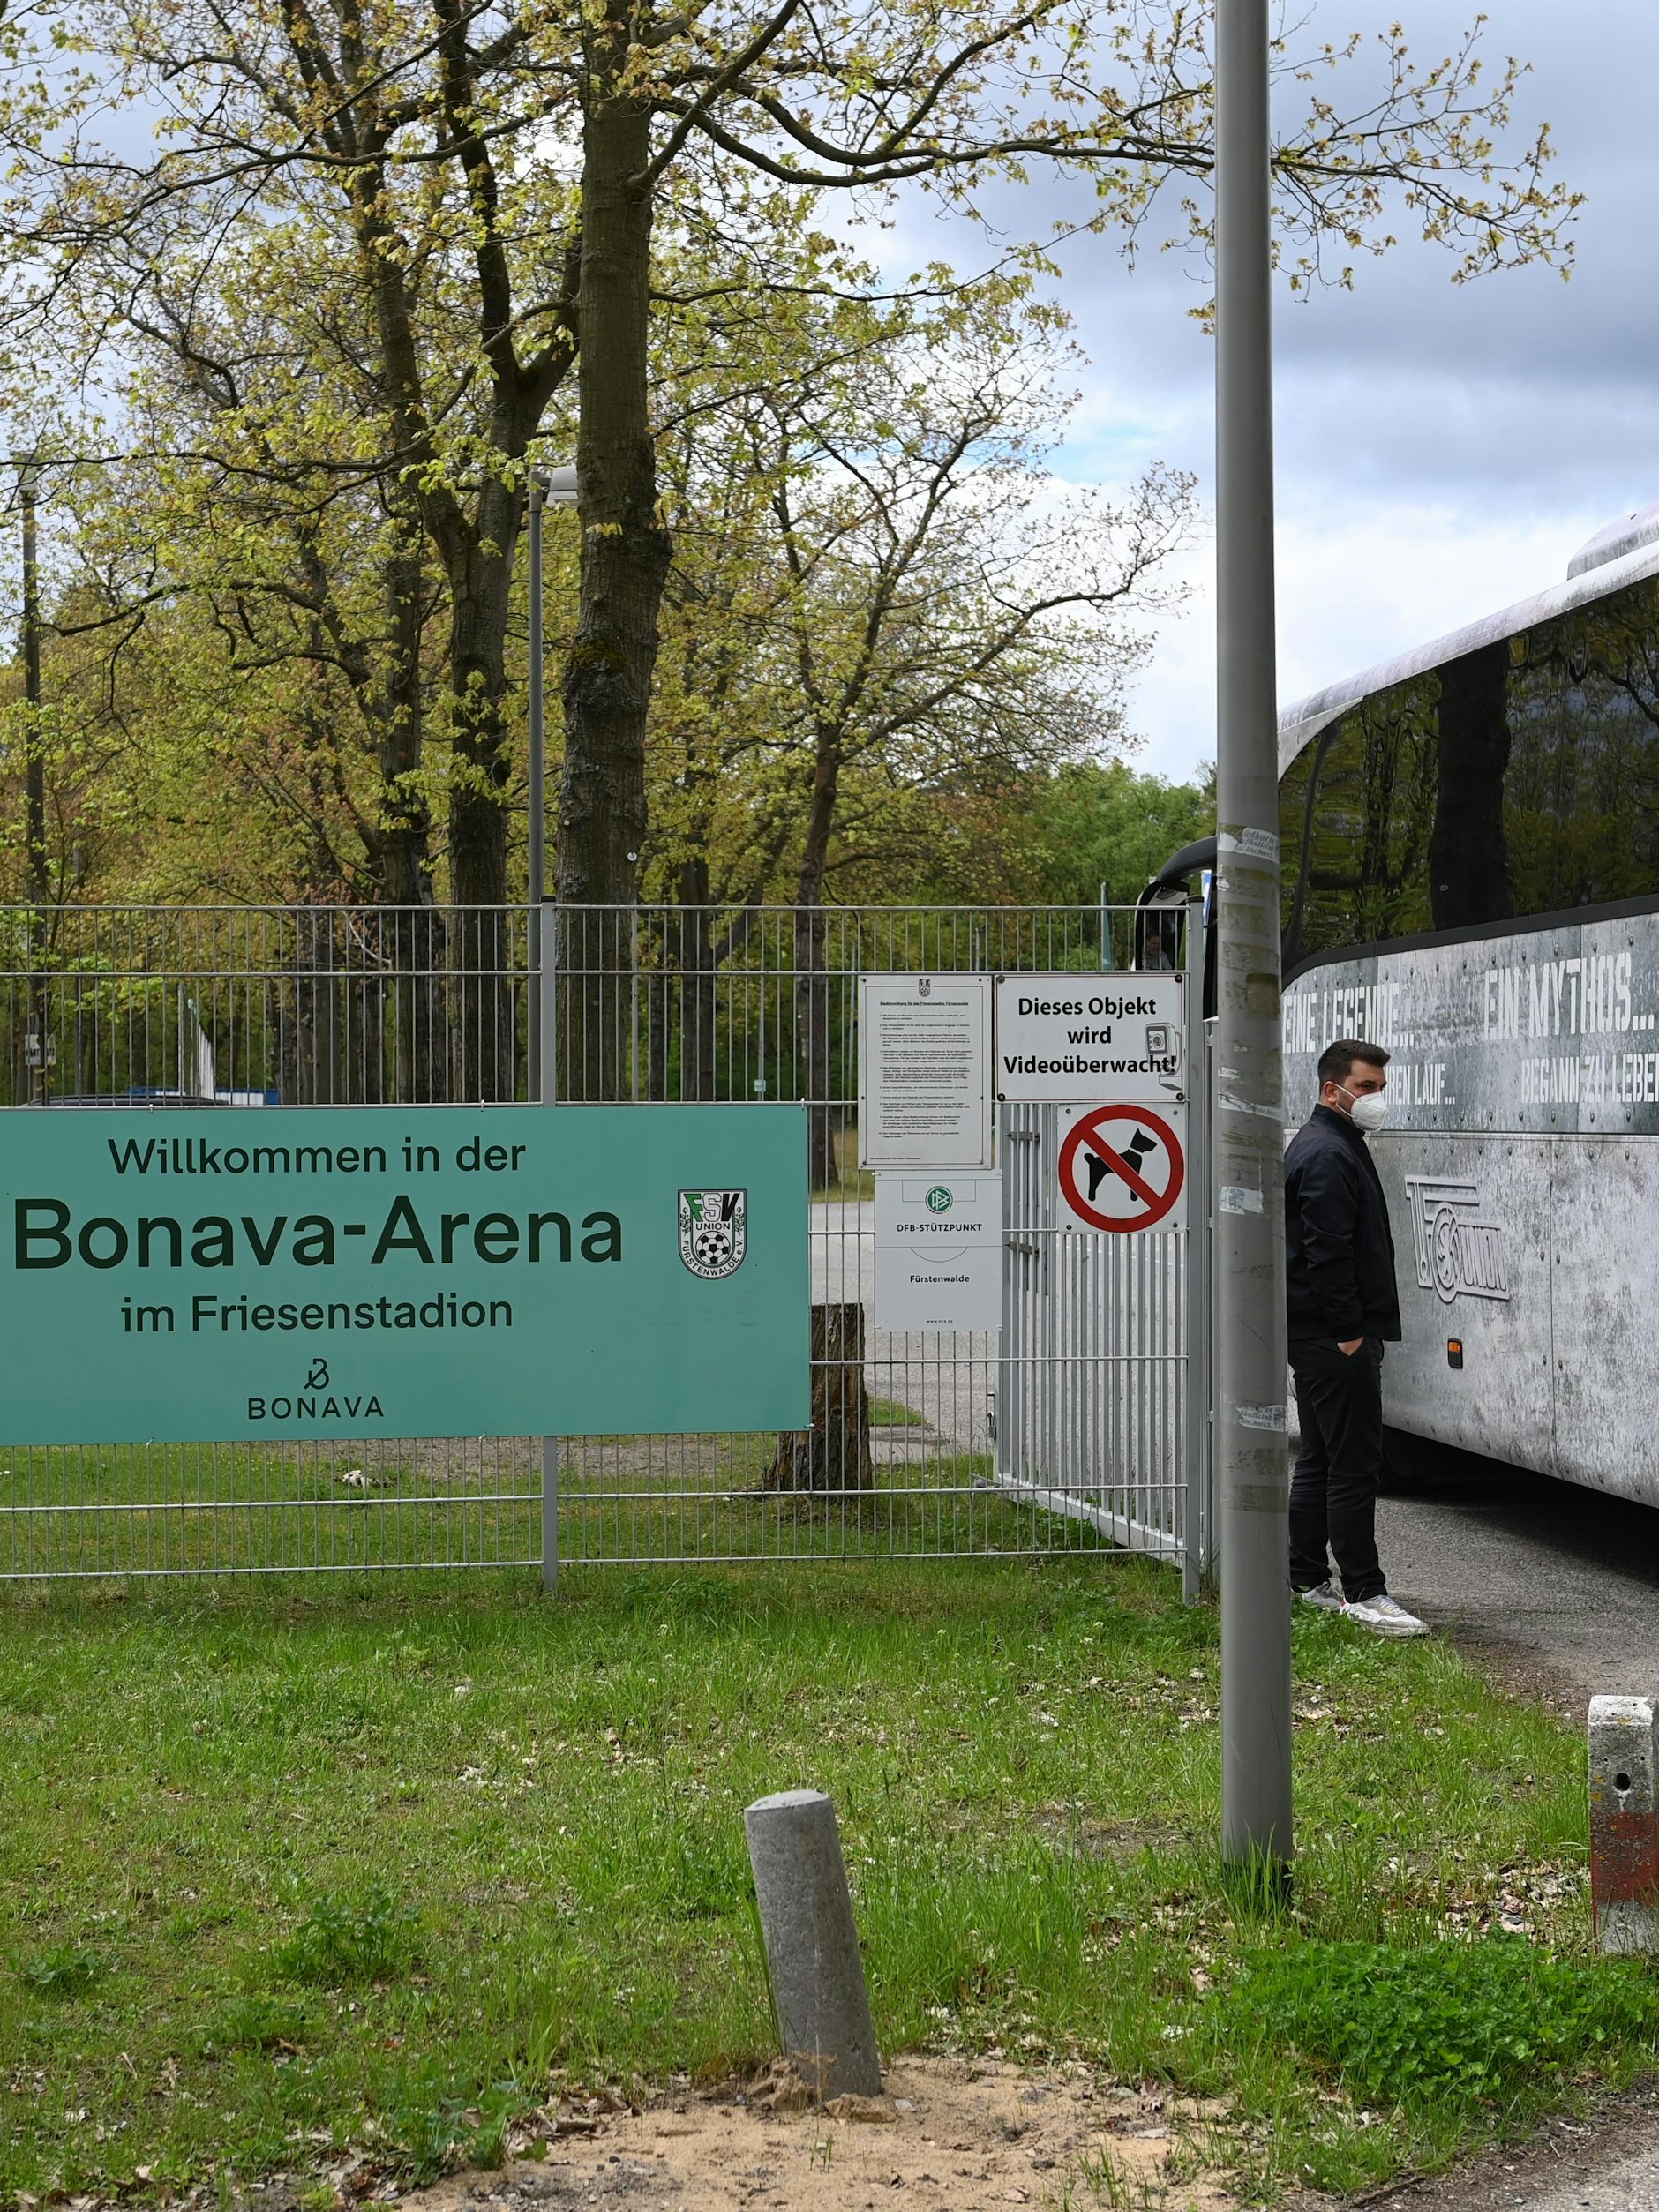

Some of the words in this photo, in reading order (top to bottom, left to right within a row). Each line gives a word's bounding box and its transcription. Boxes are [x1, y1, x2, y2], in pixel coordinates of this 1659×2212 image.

[1018, 997, 1083, 1016] Dieses
[1088, 996, 1156, 1020] Objekt
[1484, 967, 1520, 1041] EIN
[1067, 1025, 1112, 1045] wird
[1282, 993, 1317, 1054] EINE
[1003, 1054, 1177, 1075] Videoüberwacht!
[1521, 1057, 1580, 1103] BEGANN
[1584, 1055, 1606, 1103] ZU
[108, 1138, 387, 1174] Willkommen
[402, 1136, 439, 1172] in
[455, 1136, 526, 1172] der
[683, 1193, 740, 1222] FSV
[15, 1195, 623, 1271] Bonava-Arena
[897, 1222, 982, 1232] DFB-STÜTZPUNKT
[121, 1296, 175, 1332] im
[192, 1292, 513, 1331] Friesenstadion
[248, 1396, 385, 1420] BONAVA
